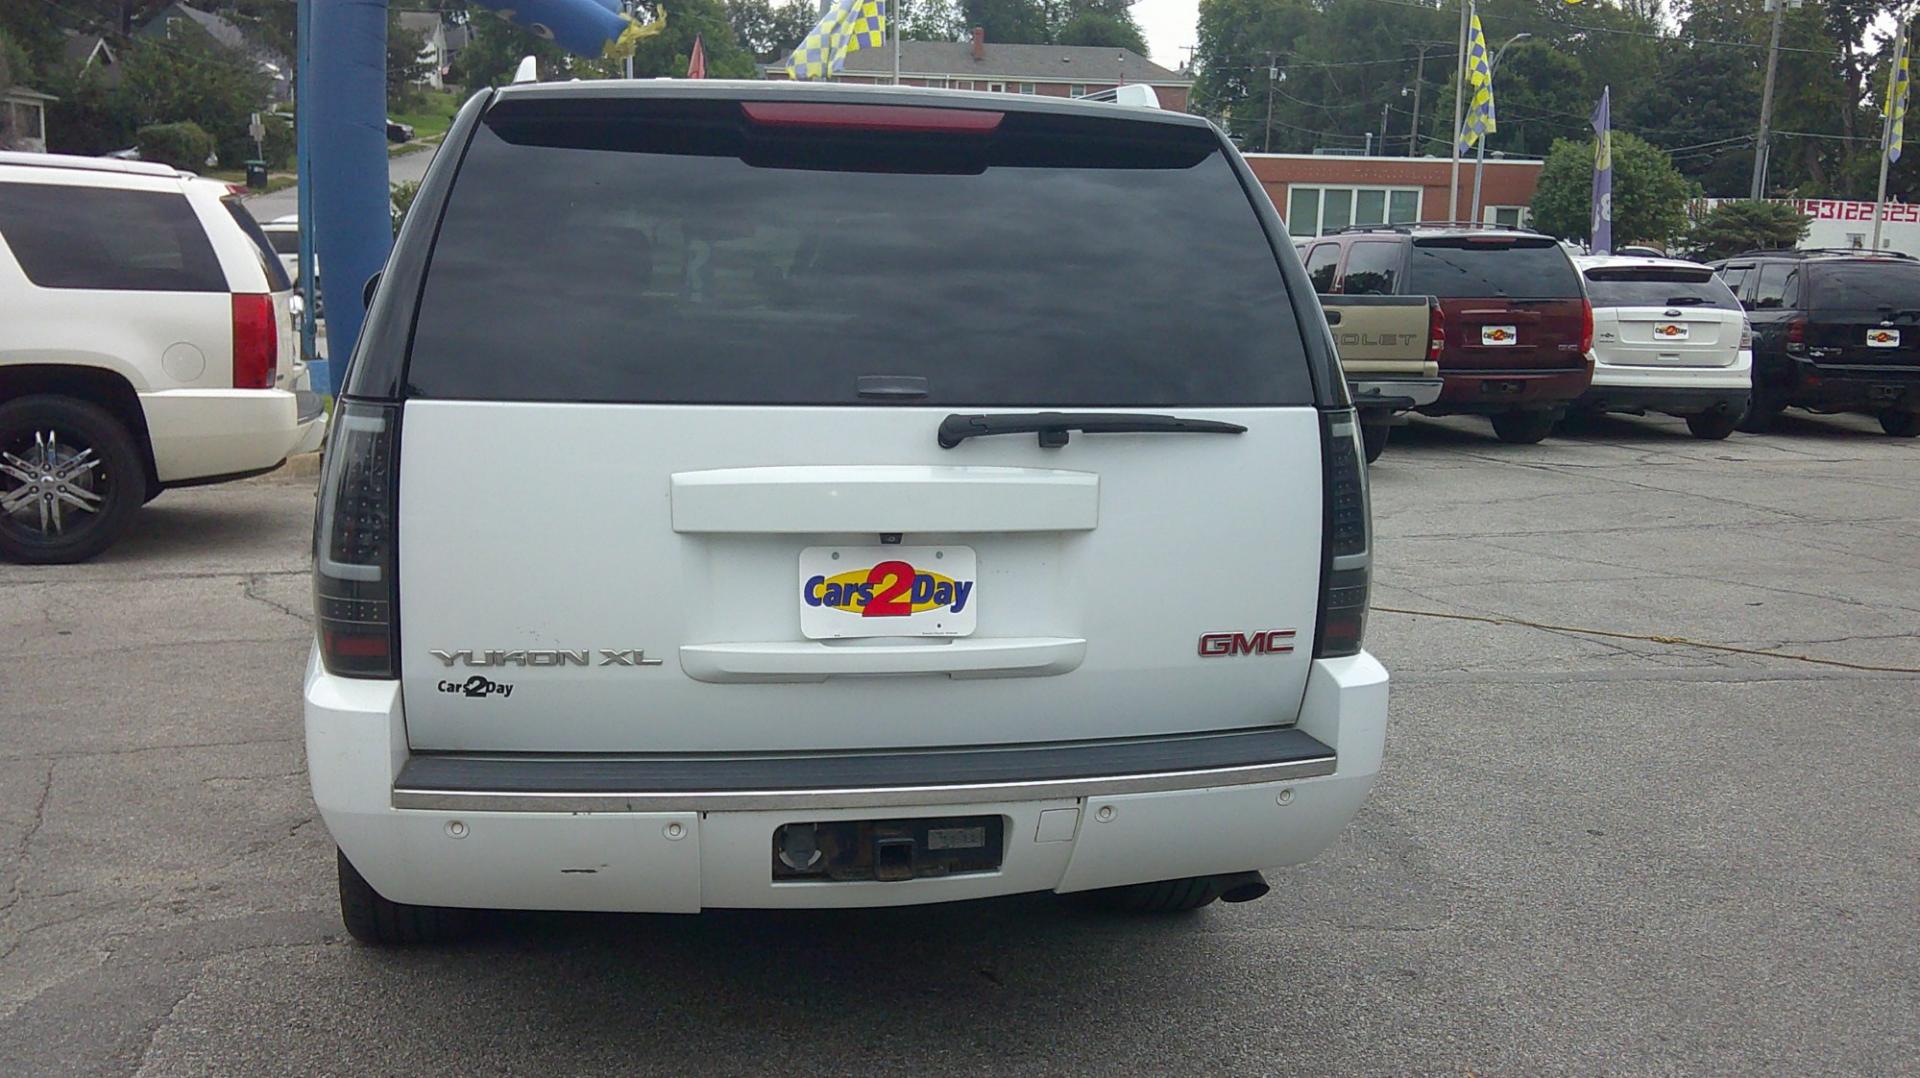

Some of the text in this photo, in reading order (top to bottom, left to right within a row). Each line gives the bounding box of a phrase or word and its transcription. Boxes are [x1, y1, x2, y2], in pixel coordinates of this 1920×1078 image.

[1333, 333, 1417, 346] OLET
[803, 560, 973, 617] Cars2Day
[1198, 628, 1297, 657] GMC
[430, 649, 663, 667] YUKON XL
[437, 675, 514, 698] Cars2Day
